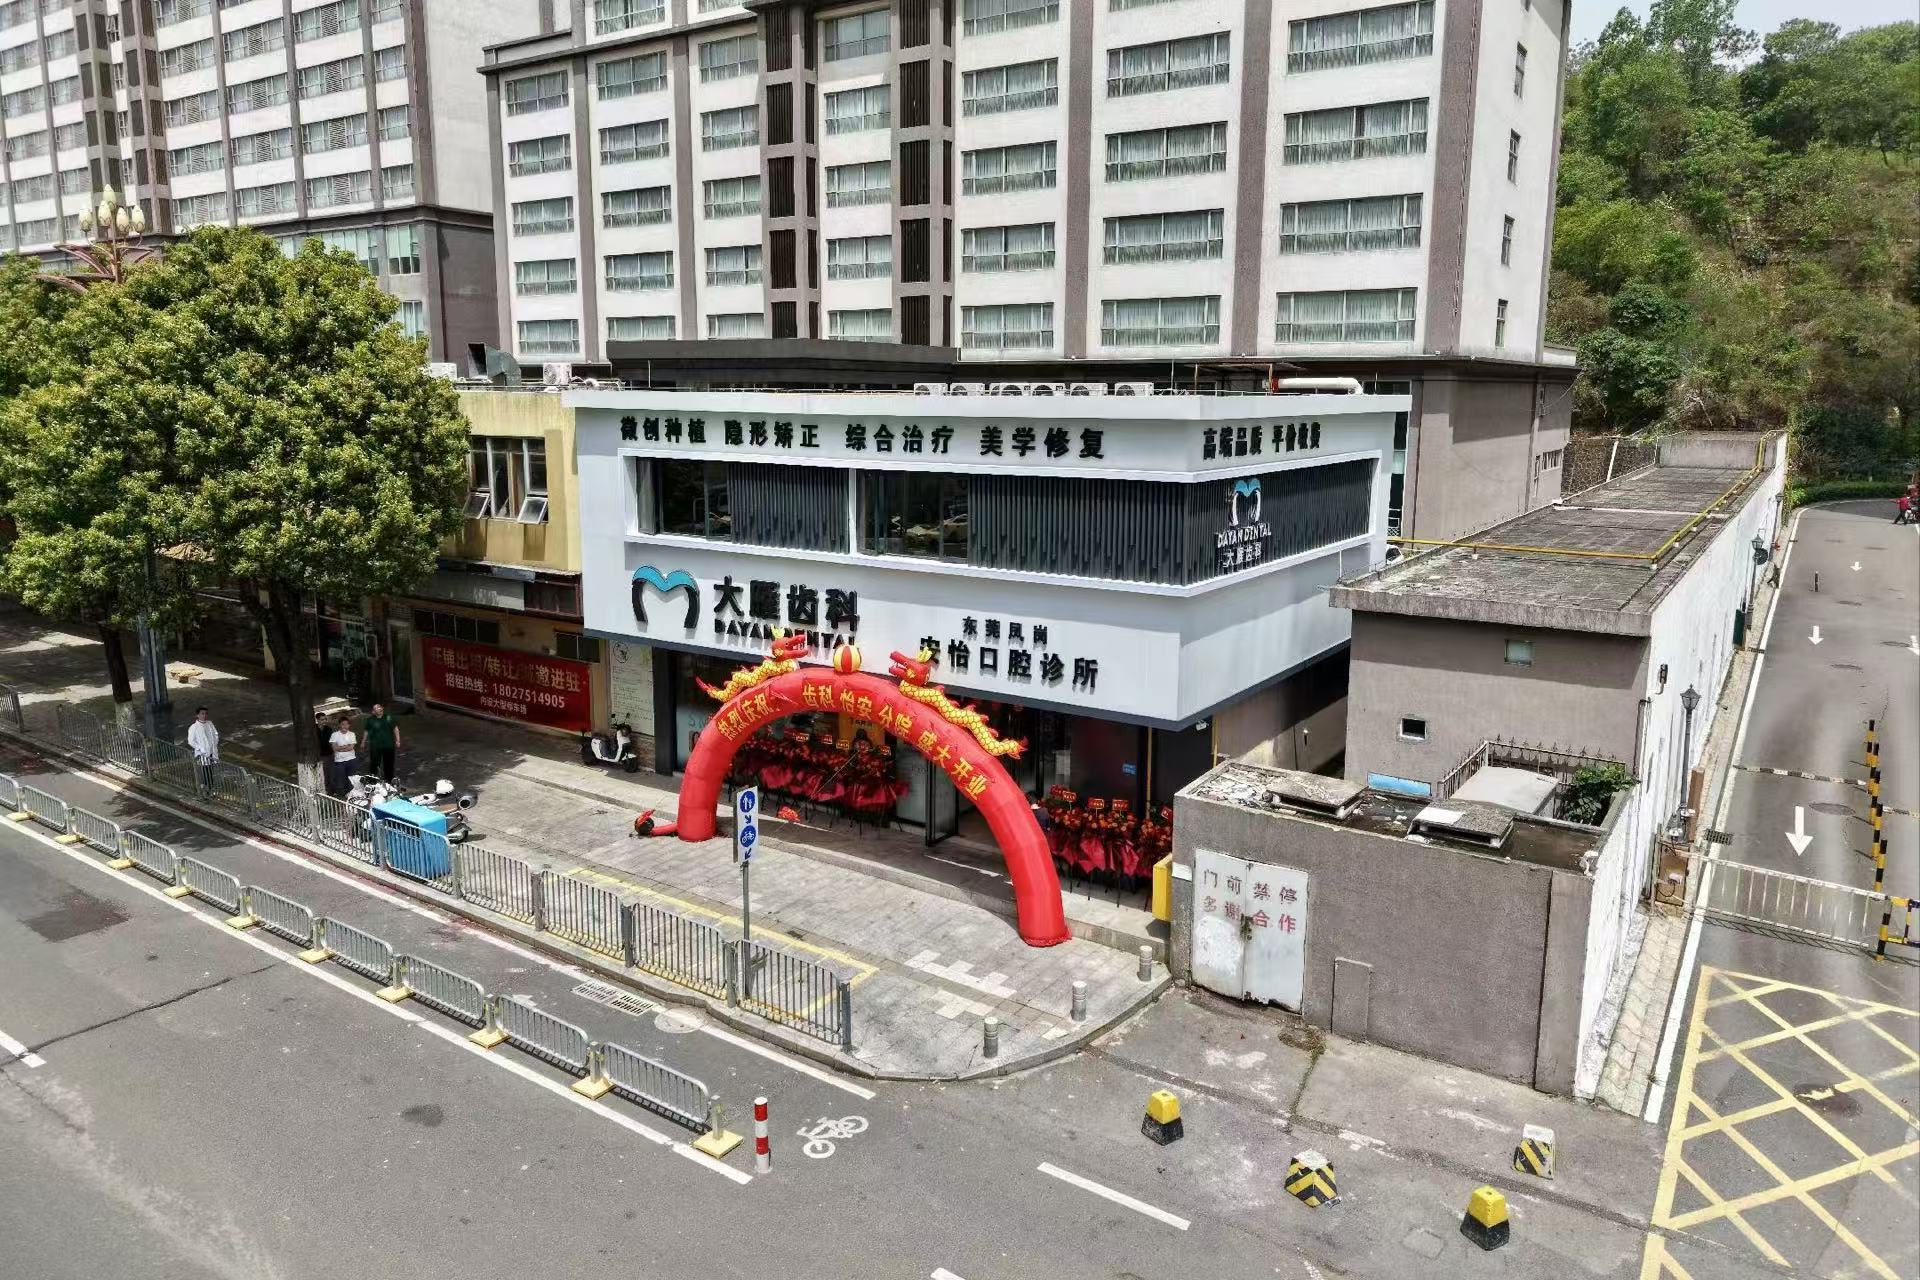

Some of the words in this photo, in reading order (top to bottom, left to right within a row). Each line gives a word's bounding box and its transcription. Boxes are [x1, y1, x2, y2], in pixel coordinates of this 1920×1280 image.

[620, 416, 707, 444] 微创种植
[724, 419, 820, 449] 隐形矫正
[845, 423, 955, 454] 综合治疗
[979, 424, 1105, 459] 美学修复
[1203, 425, 1263, 461] 高端品质
[713, 575, 859, 632] 大雁齿科
[962, 615, 1048, 645] 东莞凤岗
[919, 636, 1099, 689] 安怡口腔诊所
[493, 683, 566, 709] 18027514905
[717, 691, 770, 741] 热烈庆祝
[802, 683, 833, 709] 齿科
[840, 689, 873, 720] 怡安
[878, 703, 913, 738] 分院
[917, 730, 988, 801] 盛大开业
[1203, 869, 1298, 904] 门前禁停
